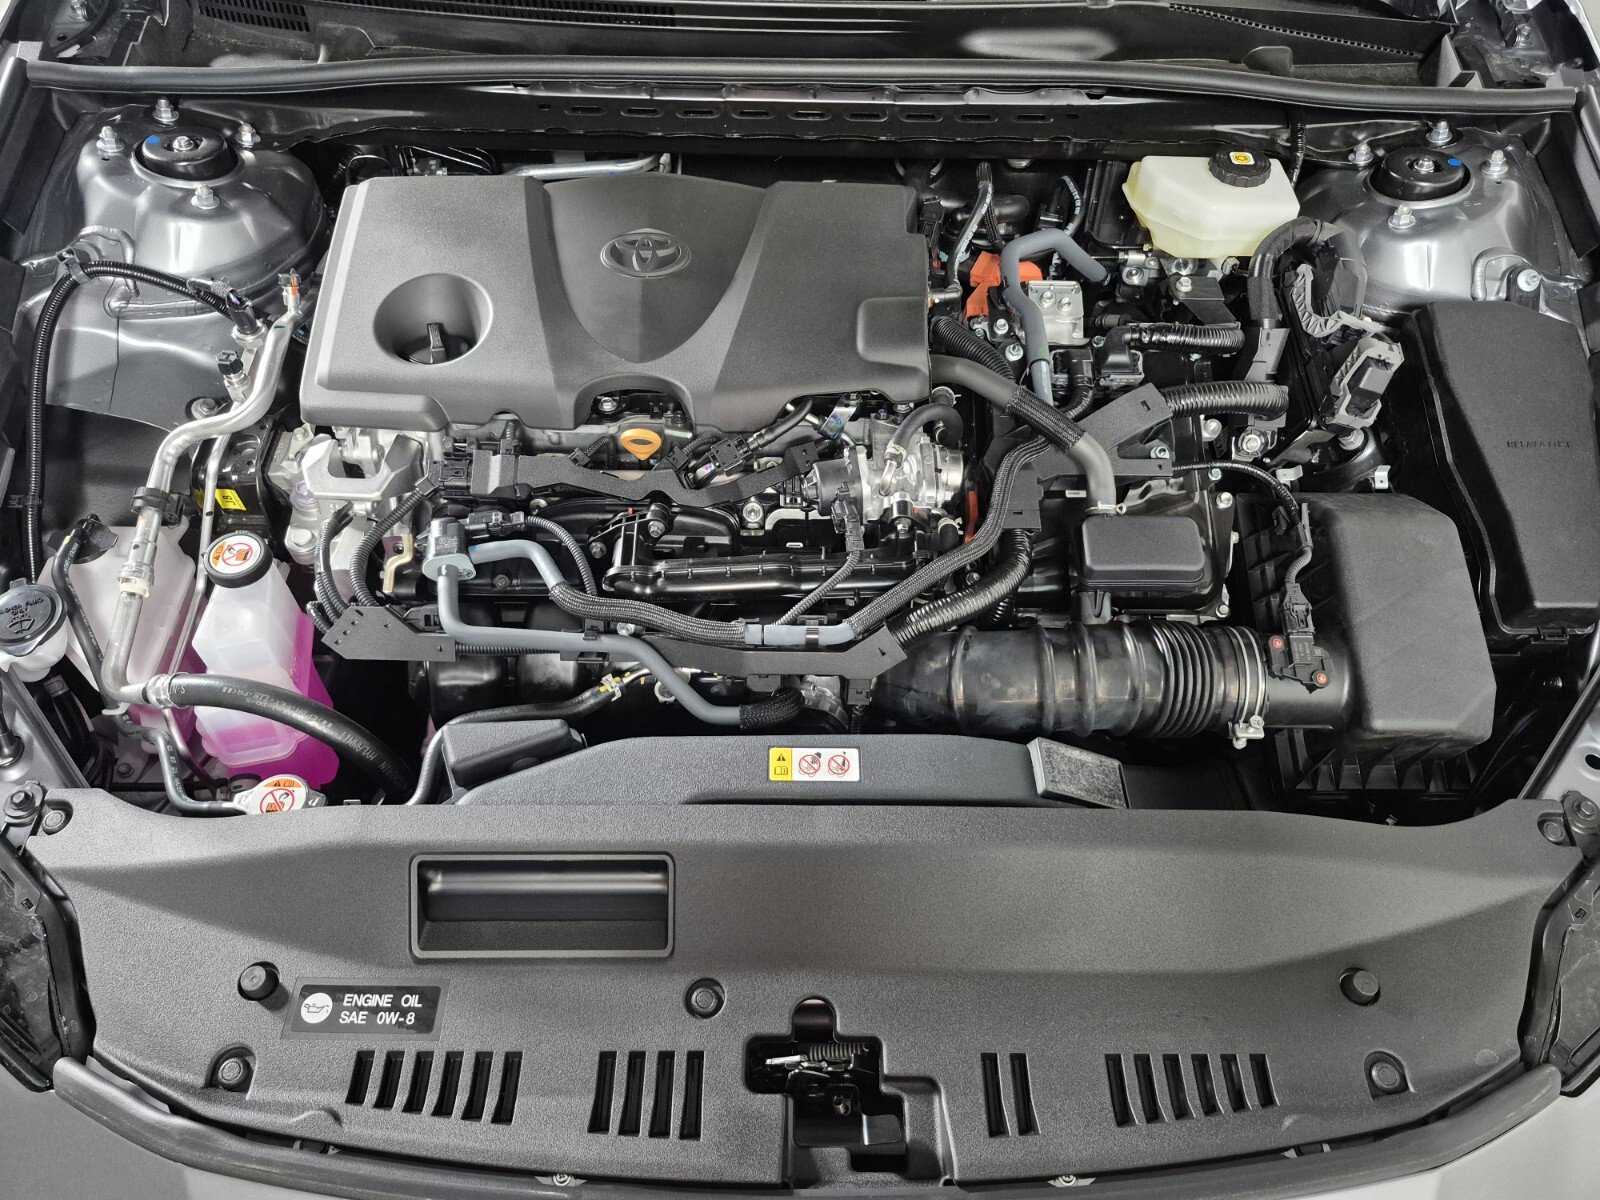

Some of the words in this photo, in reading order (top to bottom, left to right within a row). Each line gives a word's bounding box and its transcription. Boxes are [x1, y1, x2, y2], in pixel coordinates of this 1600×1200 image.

[342, 993, 393, 1007] ENGINE
[401, 994, 422, 1008] OIL
[339, 1010, 368, 1024] SAE
[376, 1012, 415, 1025] 0W-8
